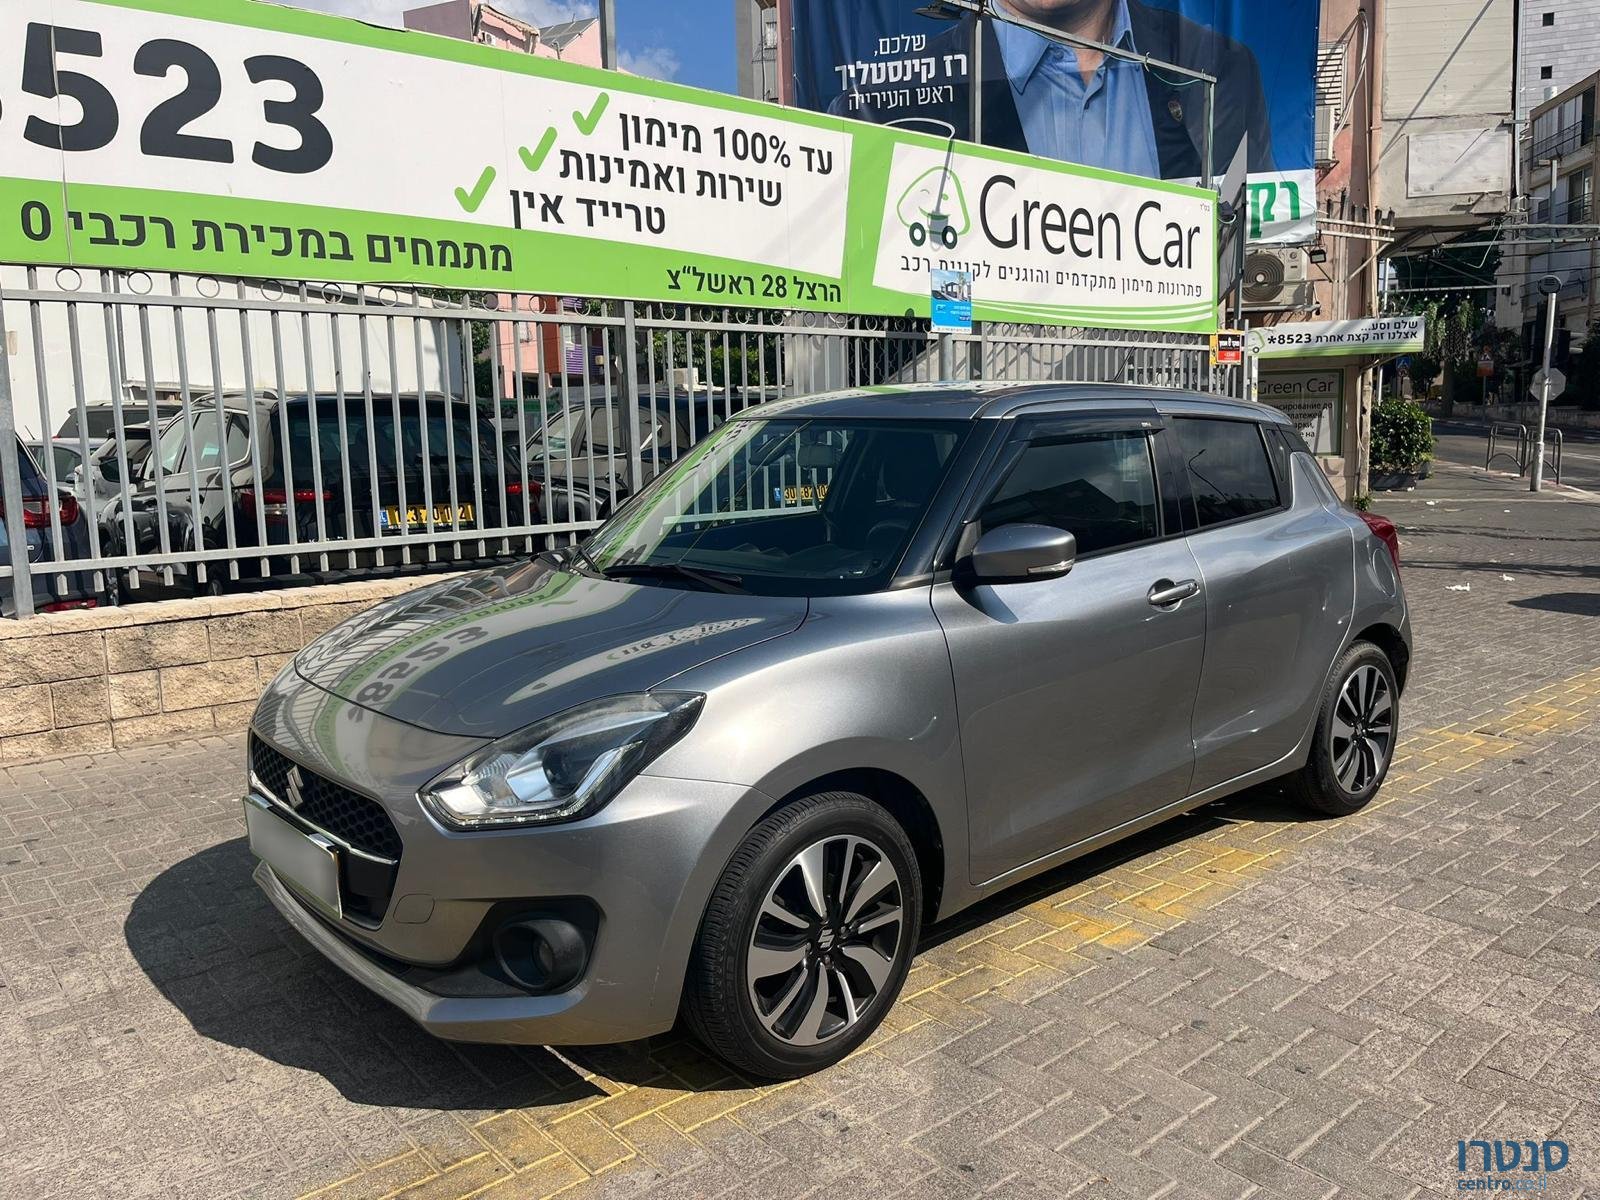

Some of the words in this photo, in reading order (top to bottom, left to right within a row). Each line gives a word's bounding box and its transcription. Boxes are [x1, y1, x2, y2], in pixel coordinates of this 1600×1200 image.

[874, 34, 926, 56] שלכם,
[834, 57, 936, 91] קינסטליך
[943, 54, 968, 77] רז
[0, 22, 333, 174] 523
[849, 89, 910, 110] העירייה
[917, 85, 953, 105] ראש
[619, 113, 702, 153] מימון
[713, 126, 791, 168] 100%
[559, 149, 685, 193] ואמינות
[799, 146, 832, 175] עד
[696, 169, 782, 206] שירות
[20, 200, 51, 242] 0
[509, 189, 565, 229] אין
[576, 197, 666, 235] טרייד
[67, 210, 176, 249] רכבי
[979, 174, 1122, 261] Green
[1134, 200, 1200, 269] Car
[192, 219, 354, 261] במכירת
[366, 233, 513, 272] מתמחים
[901, 255, 931, 273] רכב
[762, 274, 787, 298] 28
[998, 265, 1049, 284] והוגנים
[1056, 270, 1116, 292] מתקדמים
[1121, 277, 1153, 295] מימון
[793, 275, 841, 302] הרצל
[1157, 281, 1202, 298] פתרונות
[1372, 331, 1385, 341] זה
[1388, 330, 1418, 340] אצלנו
[1393, 320, 1418, 330] שלם
[1315, 335, 1343, 344] אחרת
[1347, 332, 1369, 343] קצת
[1258, 380, 1302, 394] Green
[1306, 378, 1334, 393] Car
